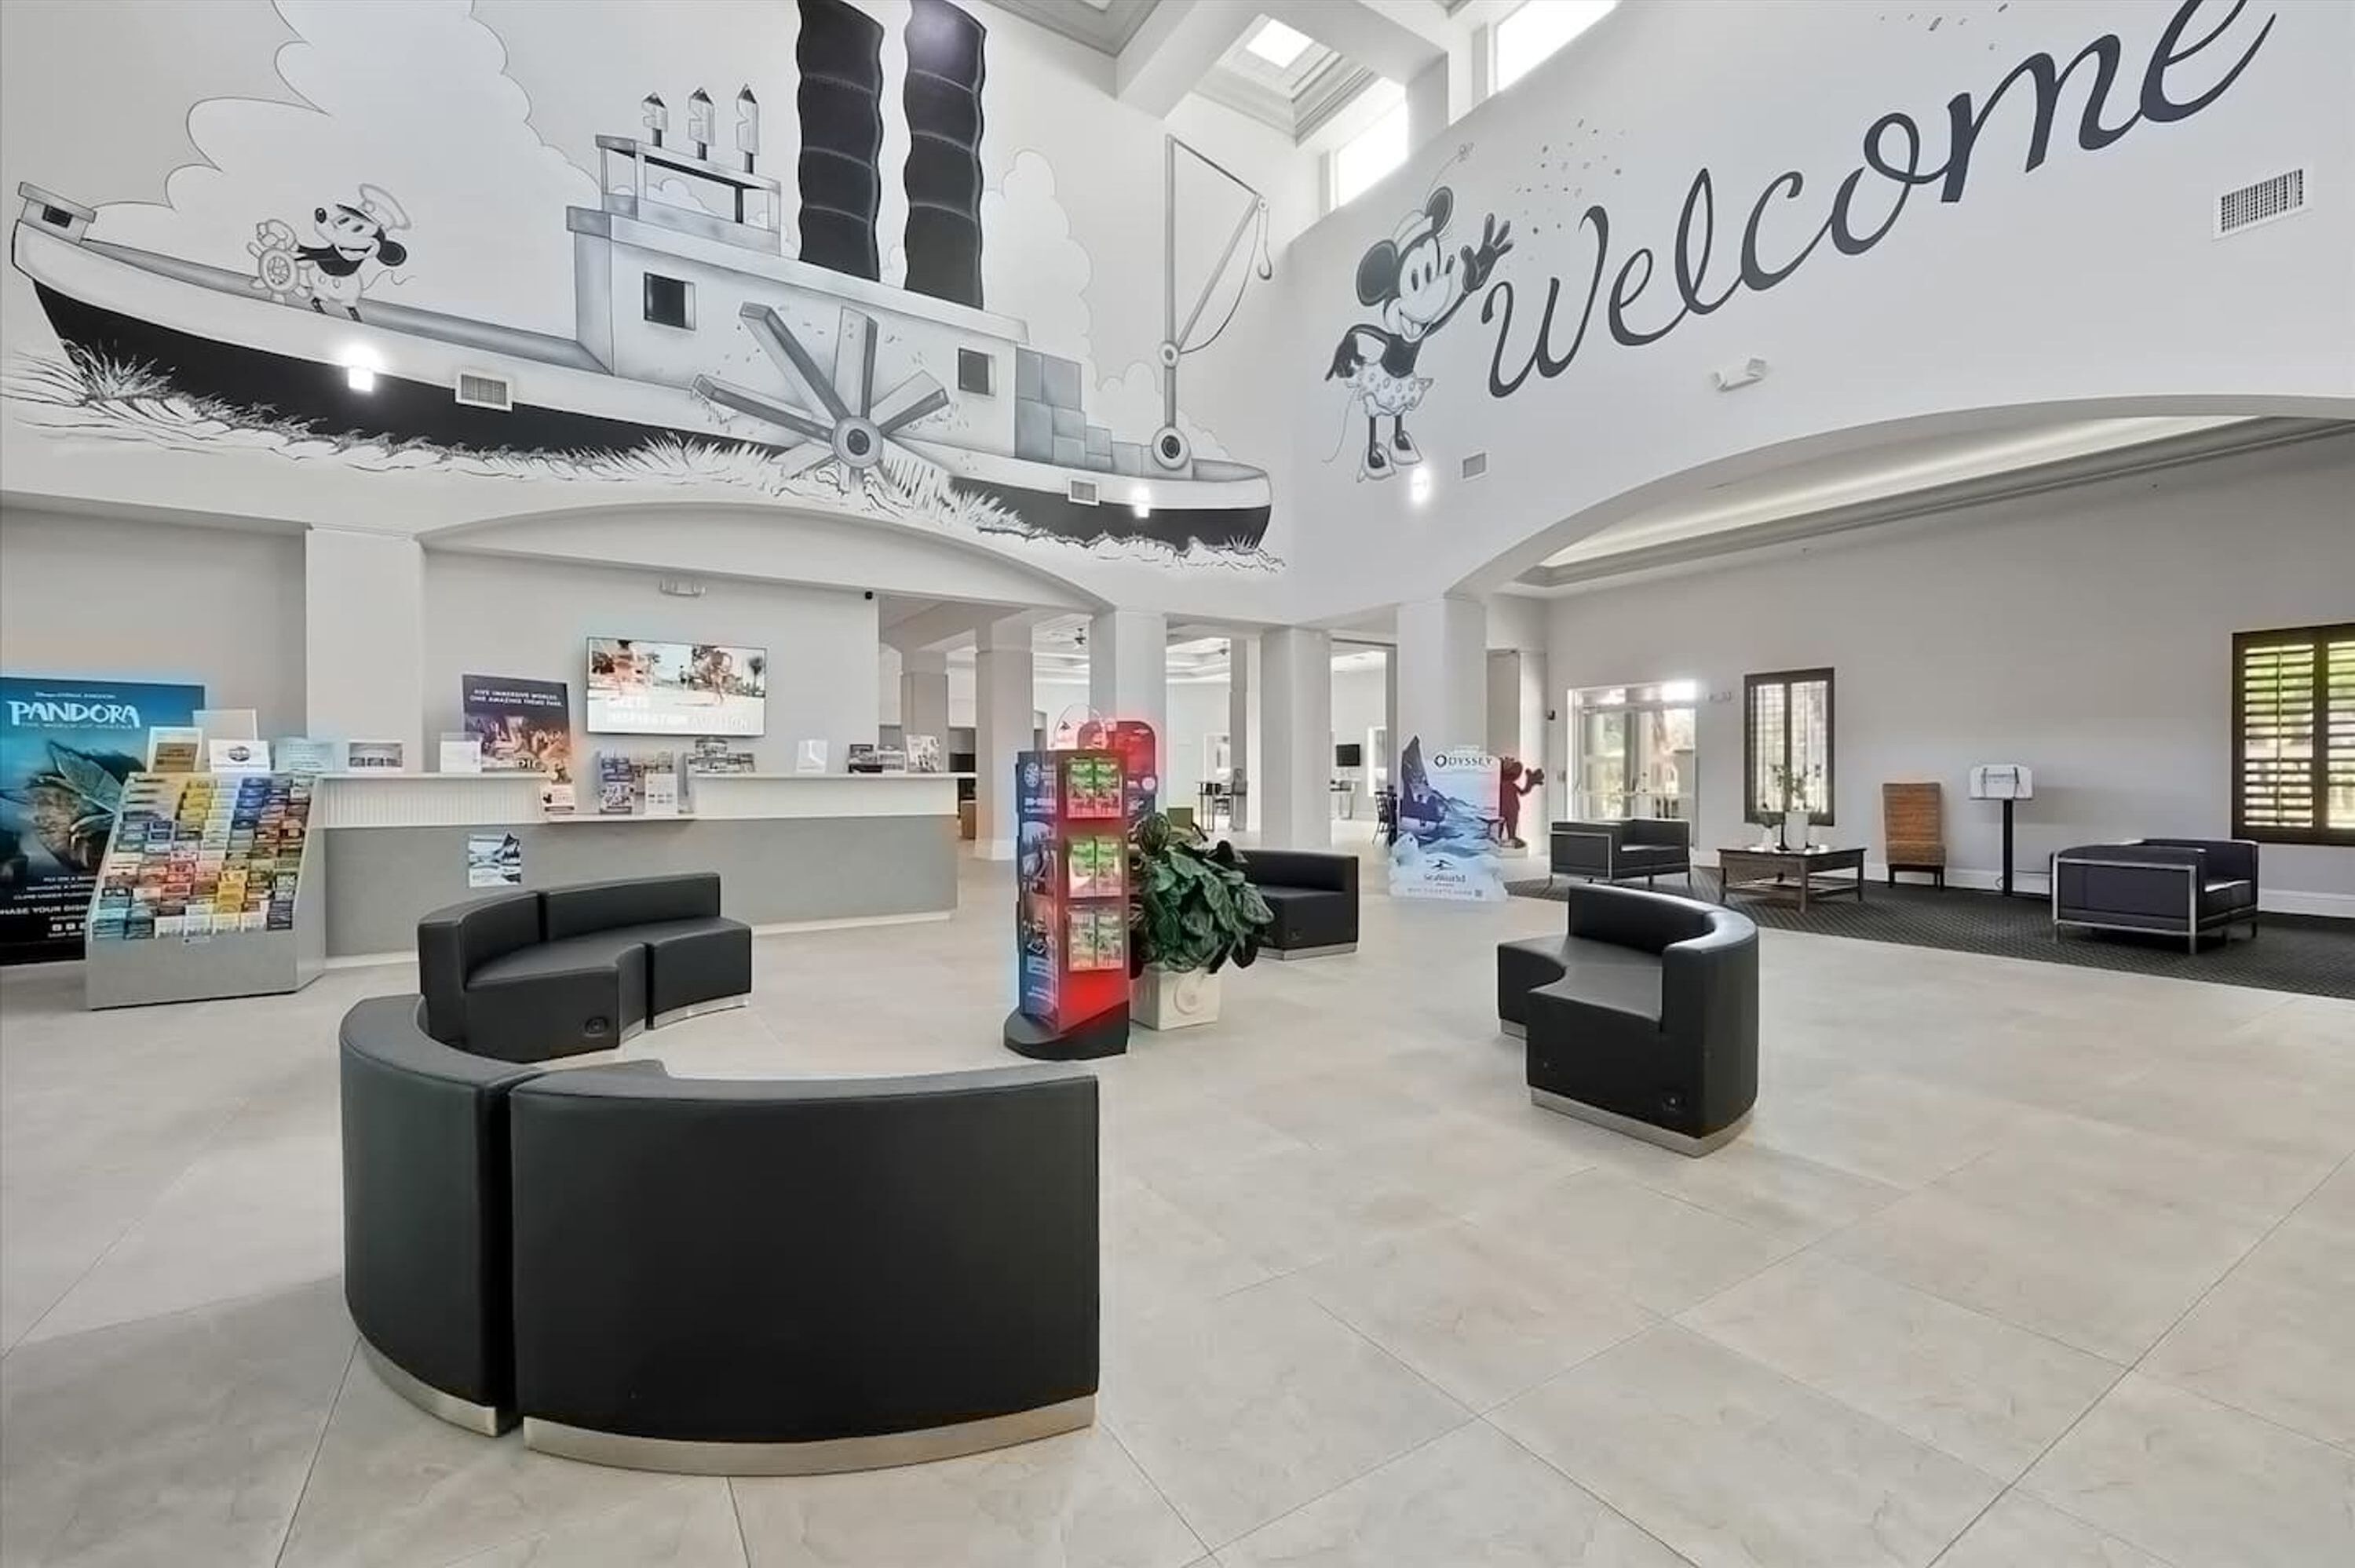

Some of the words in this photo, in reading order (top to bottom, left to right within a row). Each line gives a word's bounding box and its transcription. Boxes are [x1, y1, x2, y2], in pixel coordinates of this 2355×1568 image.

[1481, 0, 2276, 398] Welcome
[6, 700, 141, 729] PANDORA
[1434, 753, 1493, 768] ODYSSEY
[31, 905, 61, 913] YOUR
